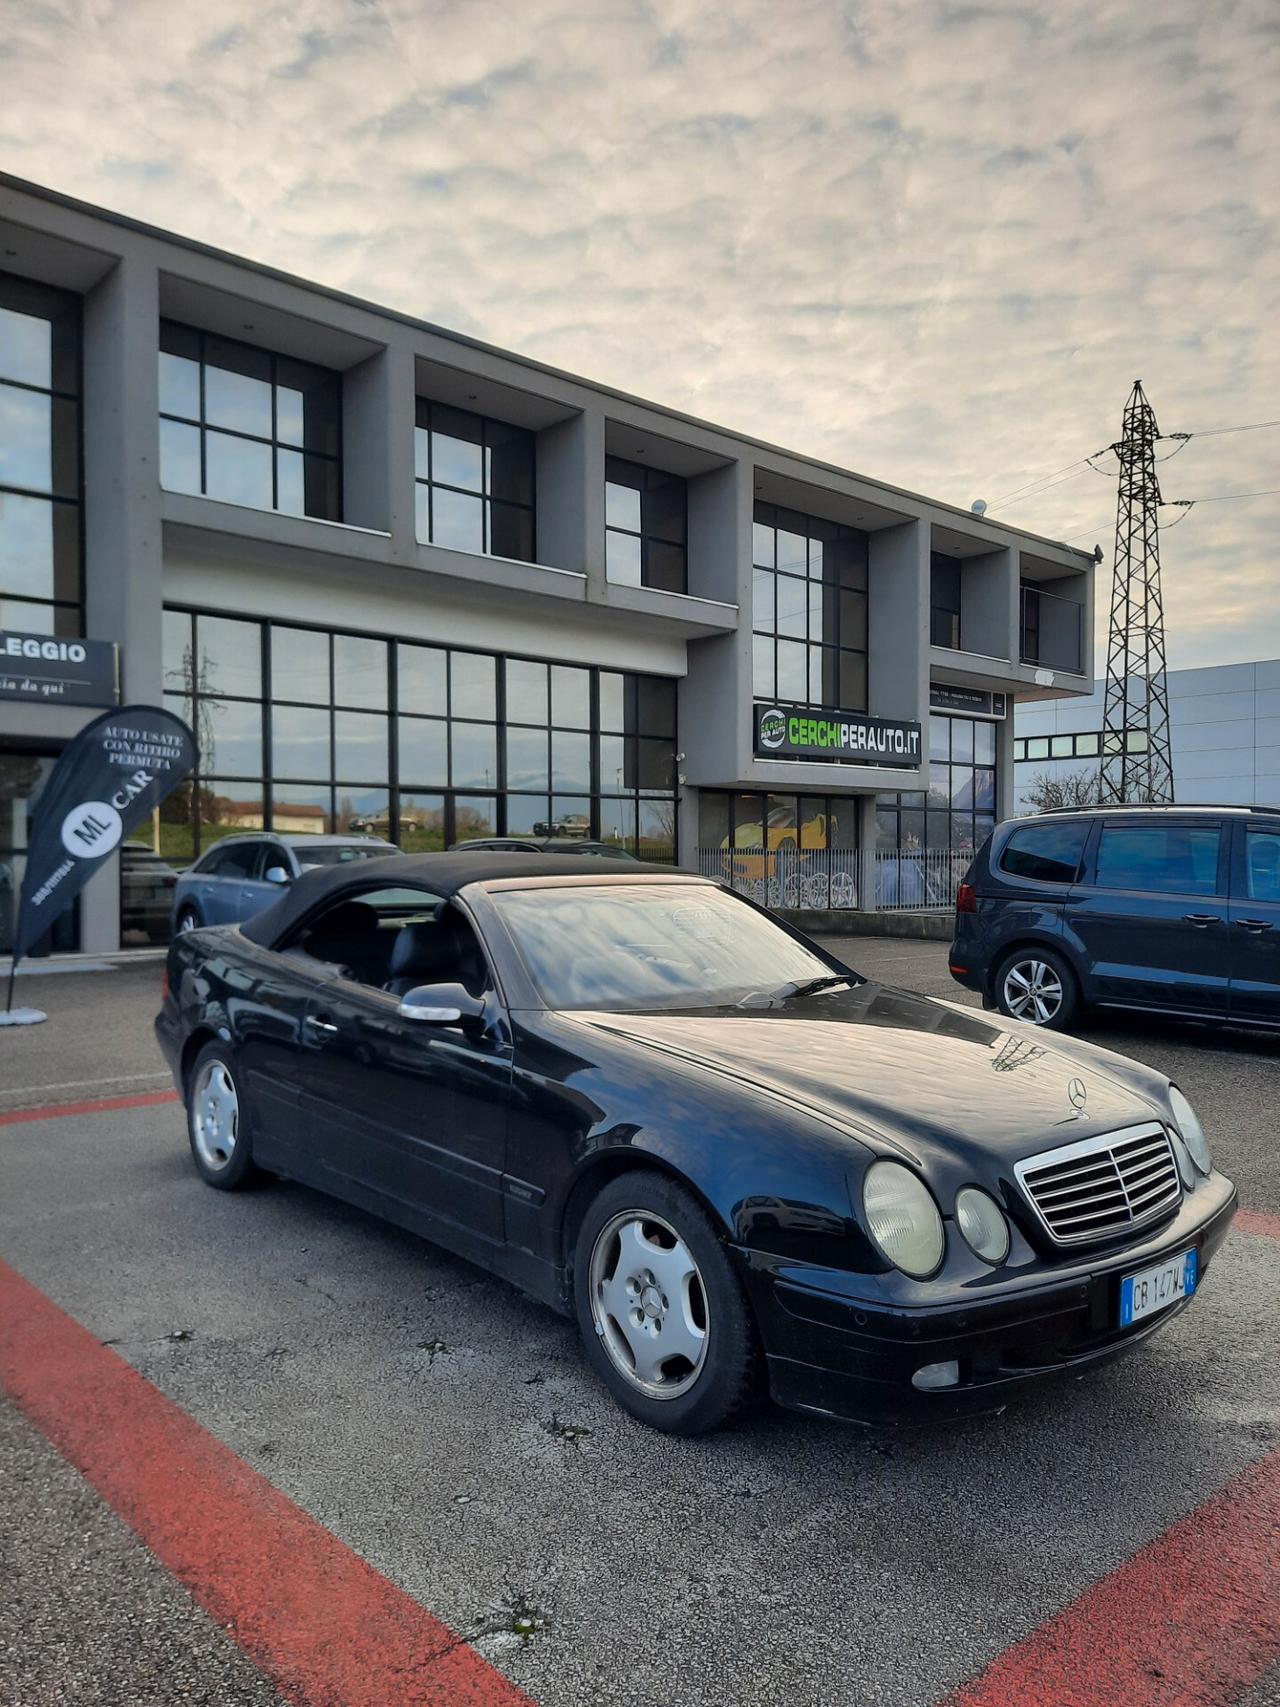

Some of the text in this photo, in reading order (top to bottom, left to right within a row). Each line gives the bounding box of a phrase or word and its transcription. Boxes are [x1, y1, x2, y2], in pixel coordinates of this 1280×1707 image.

[42, 682, 64, 696] qui
[760, 719, 786, 732] CERCHI
[104, 726, 184, 747] AUTO USATE
[788, 717, 919, 755] CERCHIPERAUTO.IT
[103, 740, 181, 758] CON RITIRO
[109, 752, 171, 770] PERMUTA
[73, 770, 154, 846] ML CAR
[1134, 1281, 1148, 1311] CB
